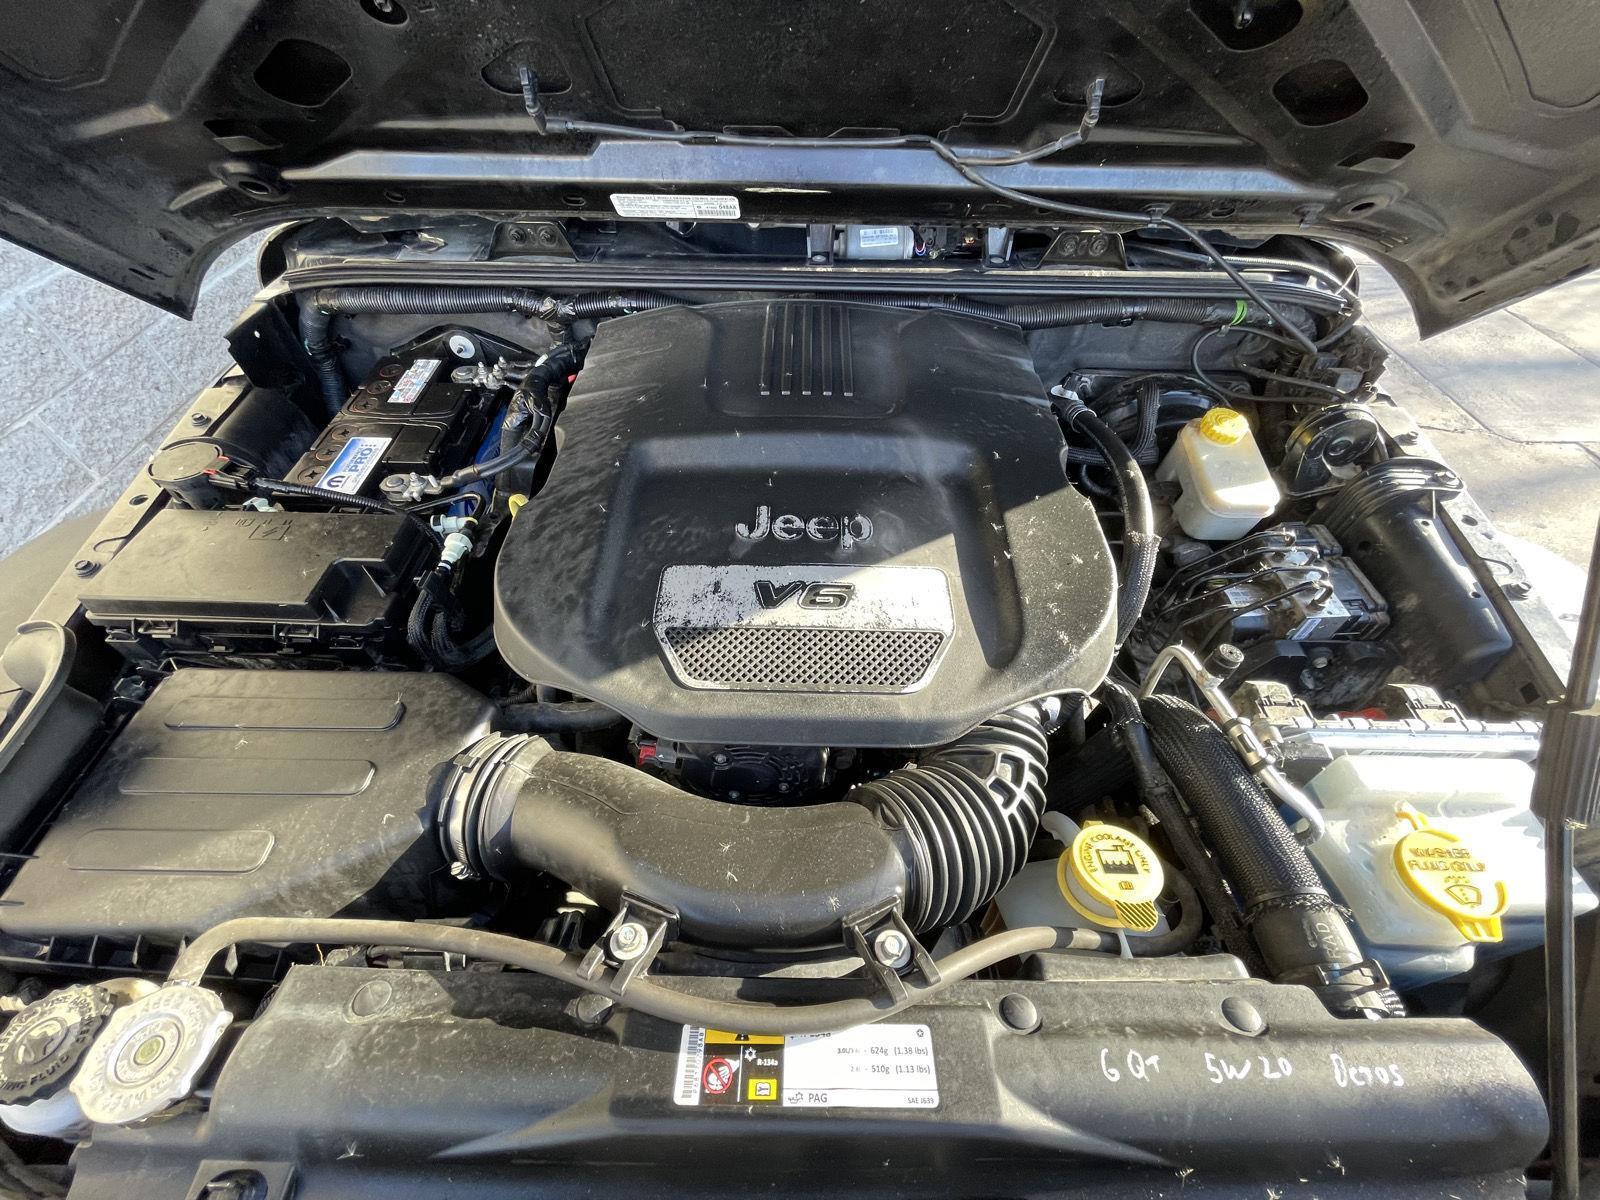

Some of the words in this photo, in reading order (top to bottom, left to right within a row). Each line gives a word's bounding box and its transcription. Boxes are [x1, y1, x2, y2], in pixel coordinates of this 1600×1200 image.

[350, 447, 373, 473] PRO
[735, 505, 874, 550] Jeep
[753, 580, 855, 611] V6
[1315, 922, 1341, 959] RAD
[757, 1058, 778, 1066] R-134a
[870, 1047, 888, 1056] 624g
[894, 1046, 913, 1056] (1.38
[914, 1046, 929, 1056] lbs)
[1100, 1048, 1121, 1082] 6
[1258, 1056, 1292, 1079] 20
[29, 1055, 71, 1086] FLUID
[871, 1065, 890, 1074] 510g
[895, 1065, 914, 1075] (1.13
[916, 1065, 931, 1074] lbs)
[808, 1093, 828, 1103] PAG
